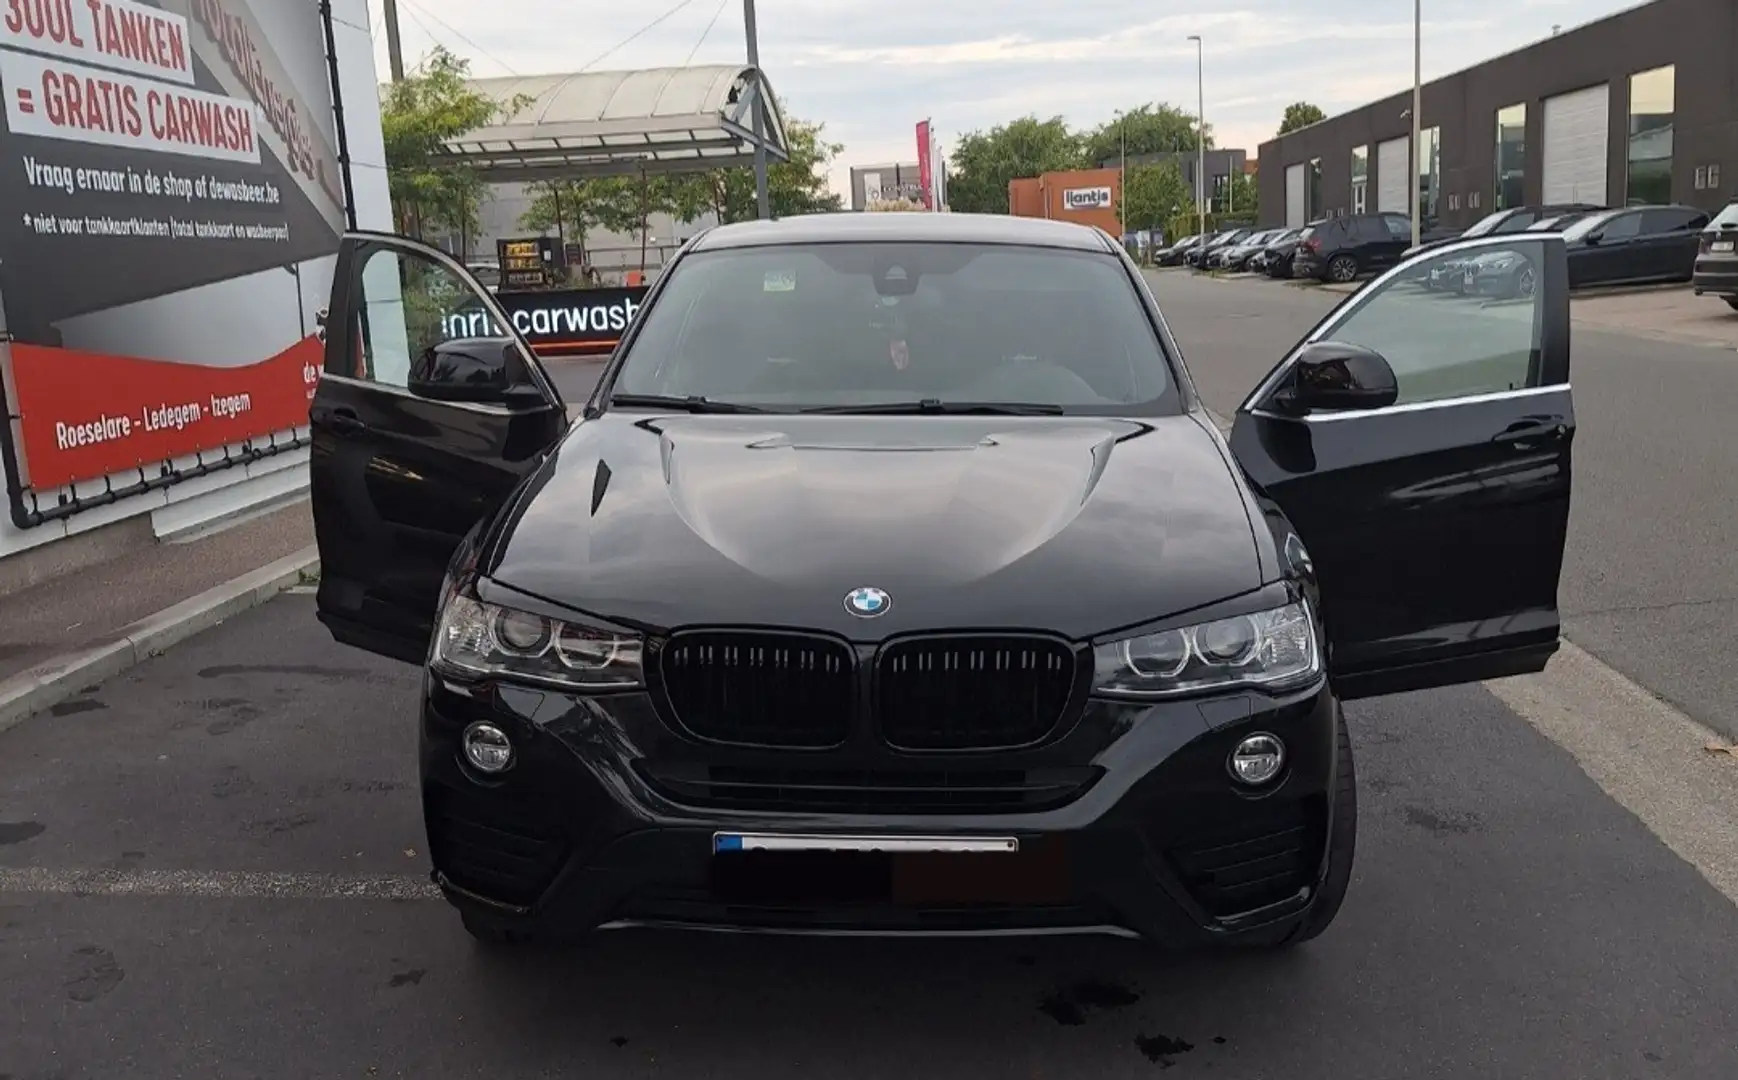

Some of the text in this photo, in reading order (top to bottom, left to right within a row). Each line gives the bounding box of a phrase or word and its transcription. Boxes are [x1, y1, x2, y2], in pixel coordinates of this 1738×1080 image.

[87, 0, 186, 72] TANKEN
[42, 68, 142, 137] GRATIS
[147, 90, 254, 153] CARWASH
[23, 155, 280, 204] Vraag ernaar in de shop of dewasbeer.be
[33, 211, 57, 234] niet
[58, 216, 83, 235] voor
[303, 360, 317, 384] de
[56, 414, 131, 450] Roeselare
[144, 400, 201, 433] Ledegem
